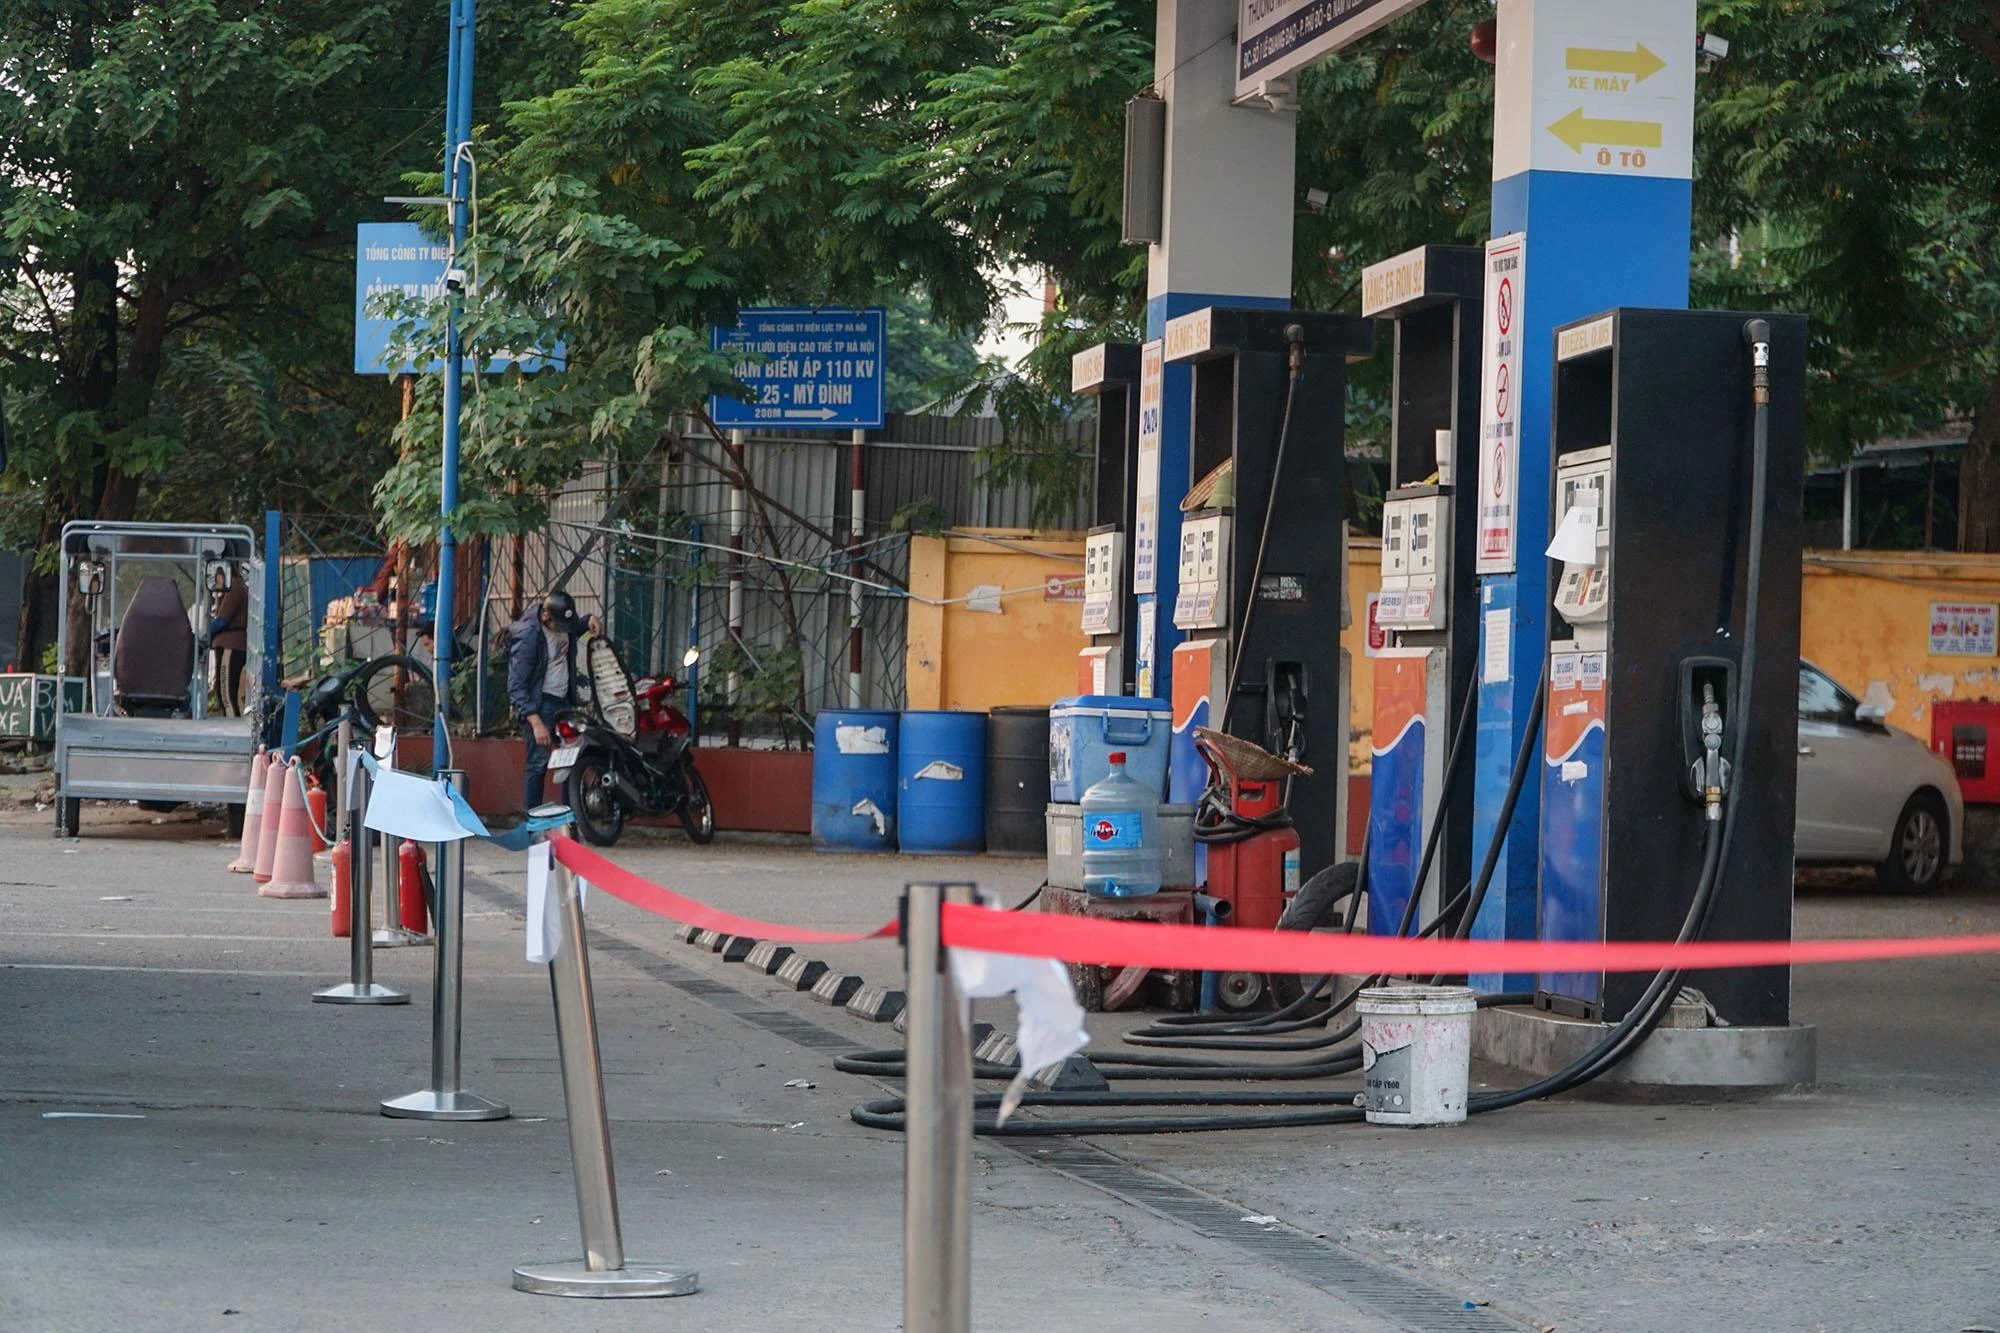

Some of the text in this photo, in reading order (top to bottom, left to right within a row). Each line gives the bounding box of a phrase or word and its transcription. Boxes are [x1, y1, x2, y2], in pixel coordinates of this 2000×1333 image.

[1567, 76, 1630, 92] XE MÁY
[1597, 147, 1646, 168] Ô TÔ
[366, 242, 388, 261] TỔNG
[391, 245, 416, 261] CÔNG
[419, 247, 430, 261] TY
[745, 342, 755, 352] TY
[777, 341, 797, 355] ĐIỆN
[799, 342, 816, 352] CAO
[817, 339, 833, 352] THẾ
[835, 342, 845, 352] TP
[847, 340, 858, 352] HÀ
[860, 341, 875, 355] NỘI
[1167, 319, 1208, 356] XĂNG 95
[731, 354, 875, 382] RẠM BIẾN ÁP 110 KV
[742, 384, 779, 404] 1.25
[793, 380, 814, 404] MỸ
[818, 380, 852, 404] ĐÌNH
[755, 408, 781, 418] 200M
[1143, 408, 1158, 435] 24/24
[1384, 515, 1391, 552] 4
[1411, 513, 1418, 552] 3
[1201, 531, 1206, 563] 5
[1065, 588, 1076, 596] NO
